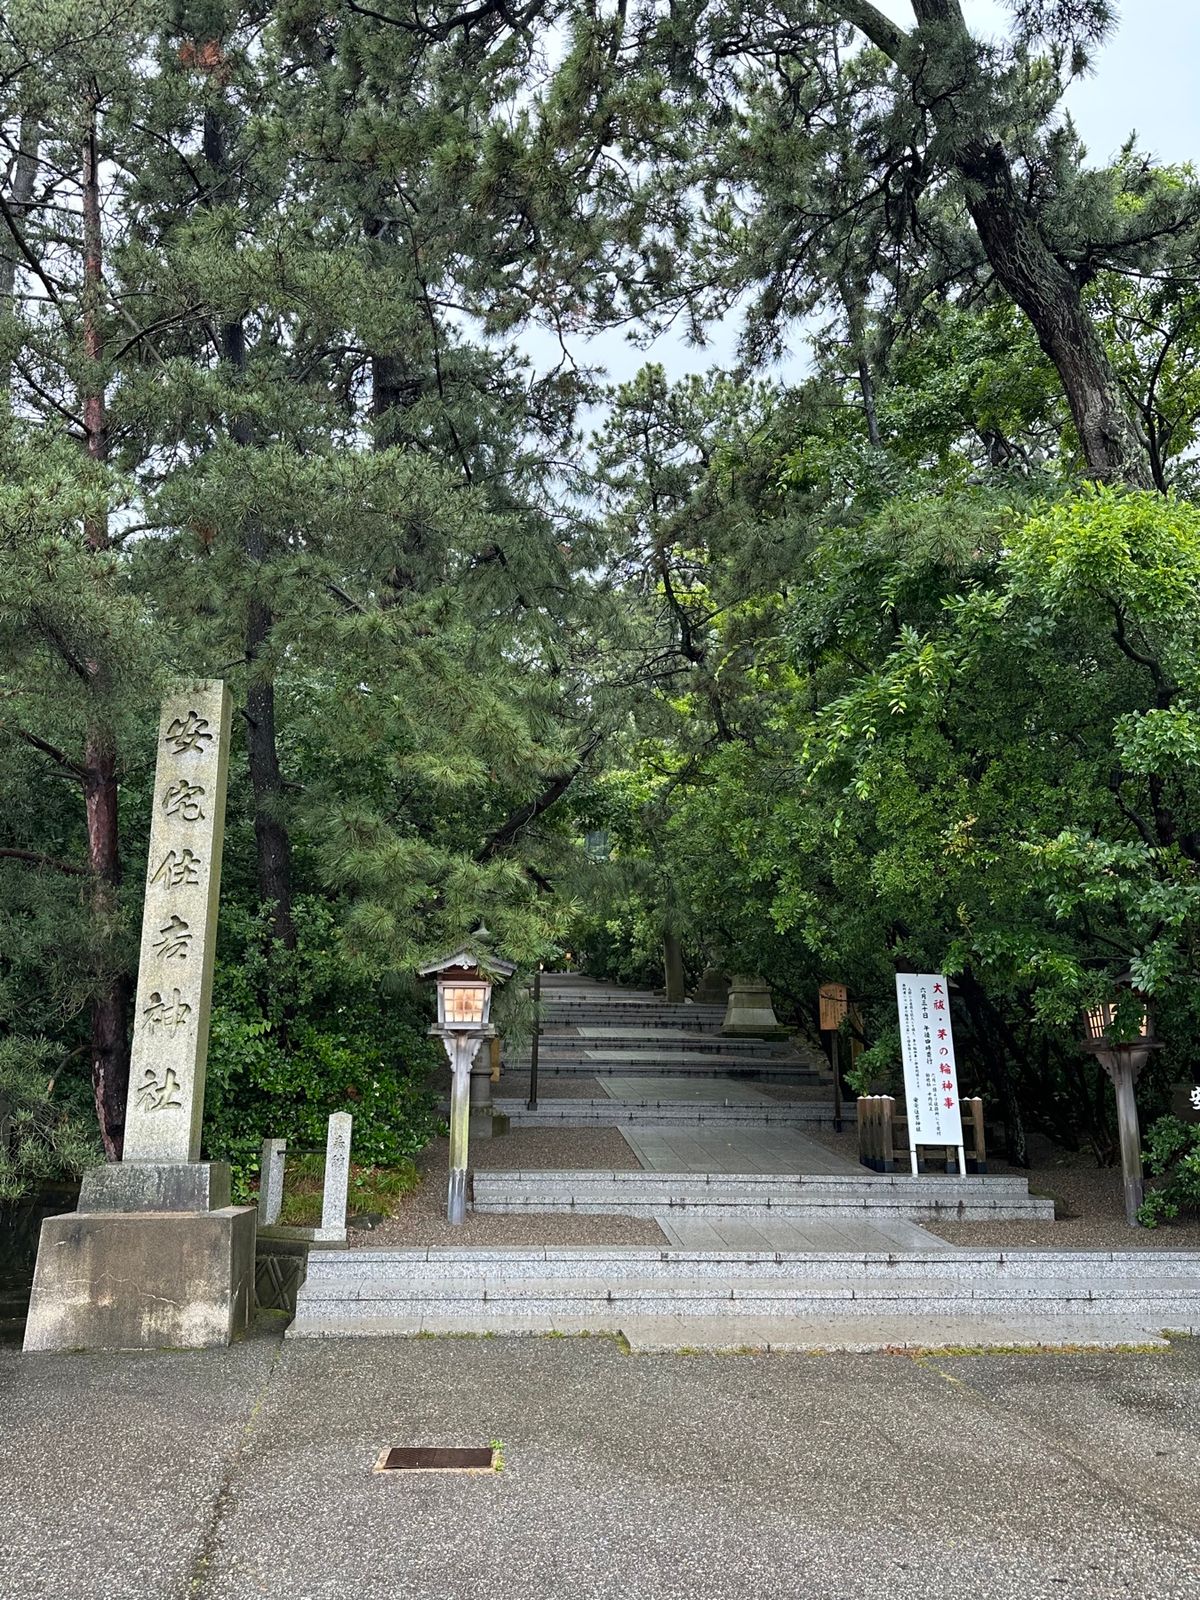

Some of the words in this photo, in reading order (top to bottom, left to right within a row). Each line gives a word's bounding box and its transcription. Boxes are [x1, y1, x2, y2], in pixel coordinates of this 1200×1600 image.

[137, 711, 213, 1111] 安宅住吉神社
